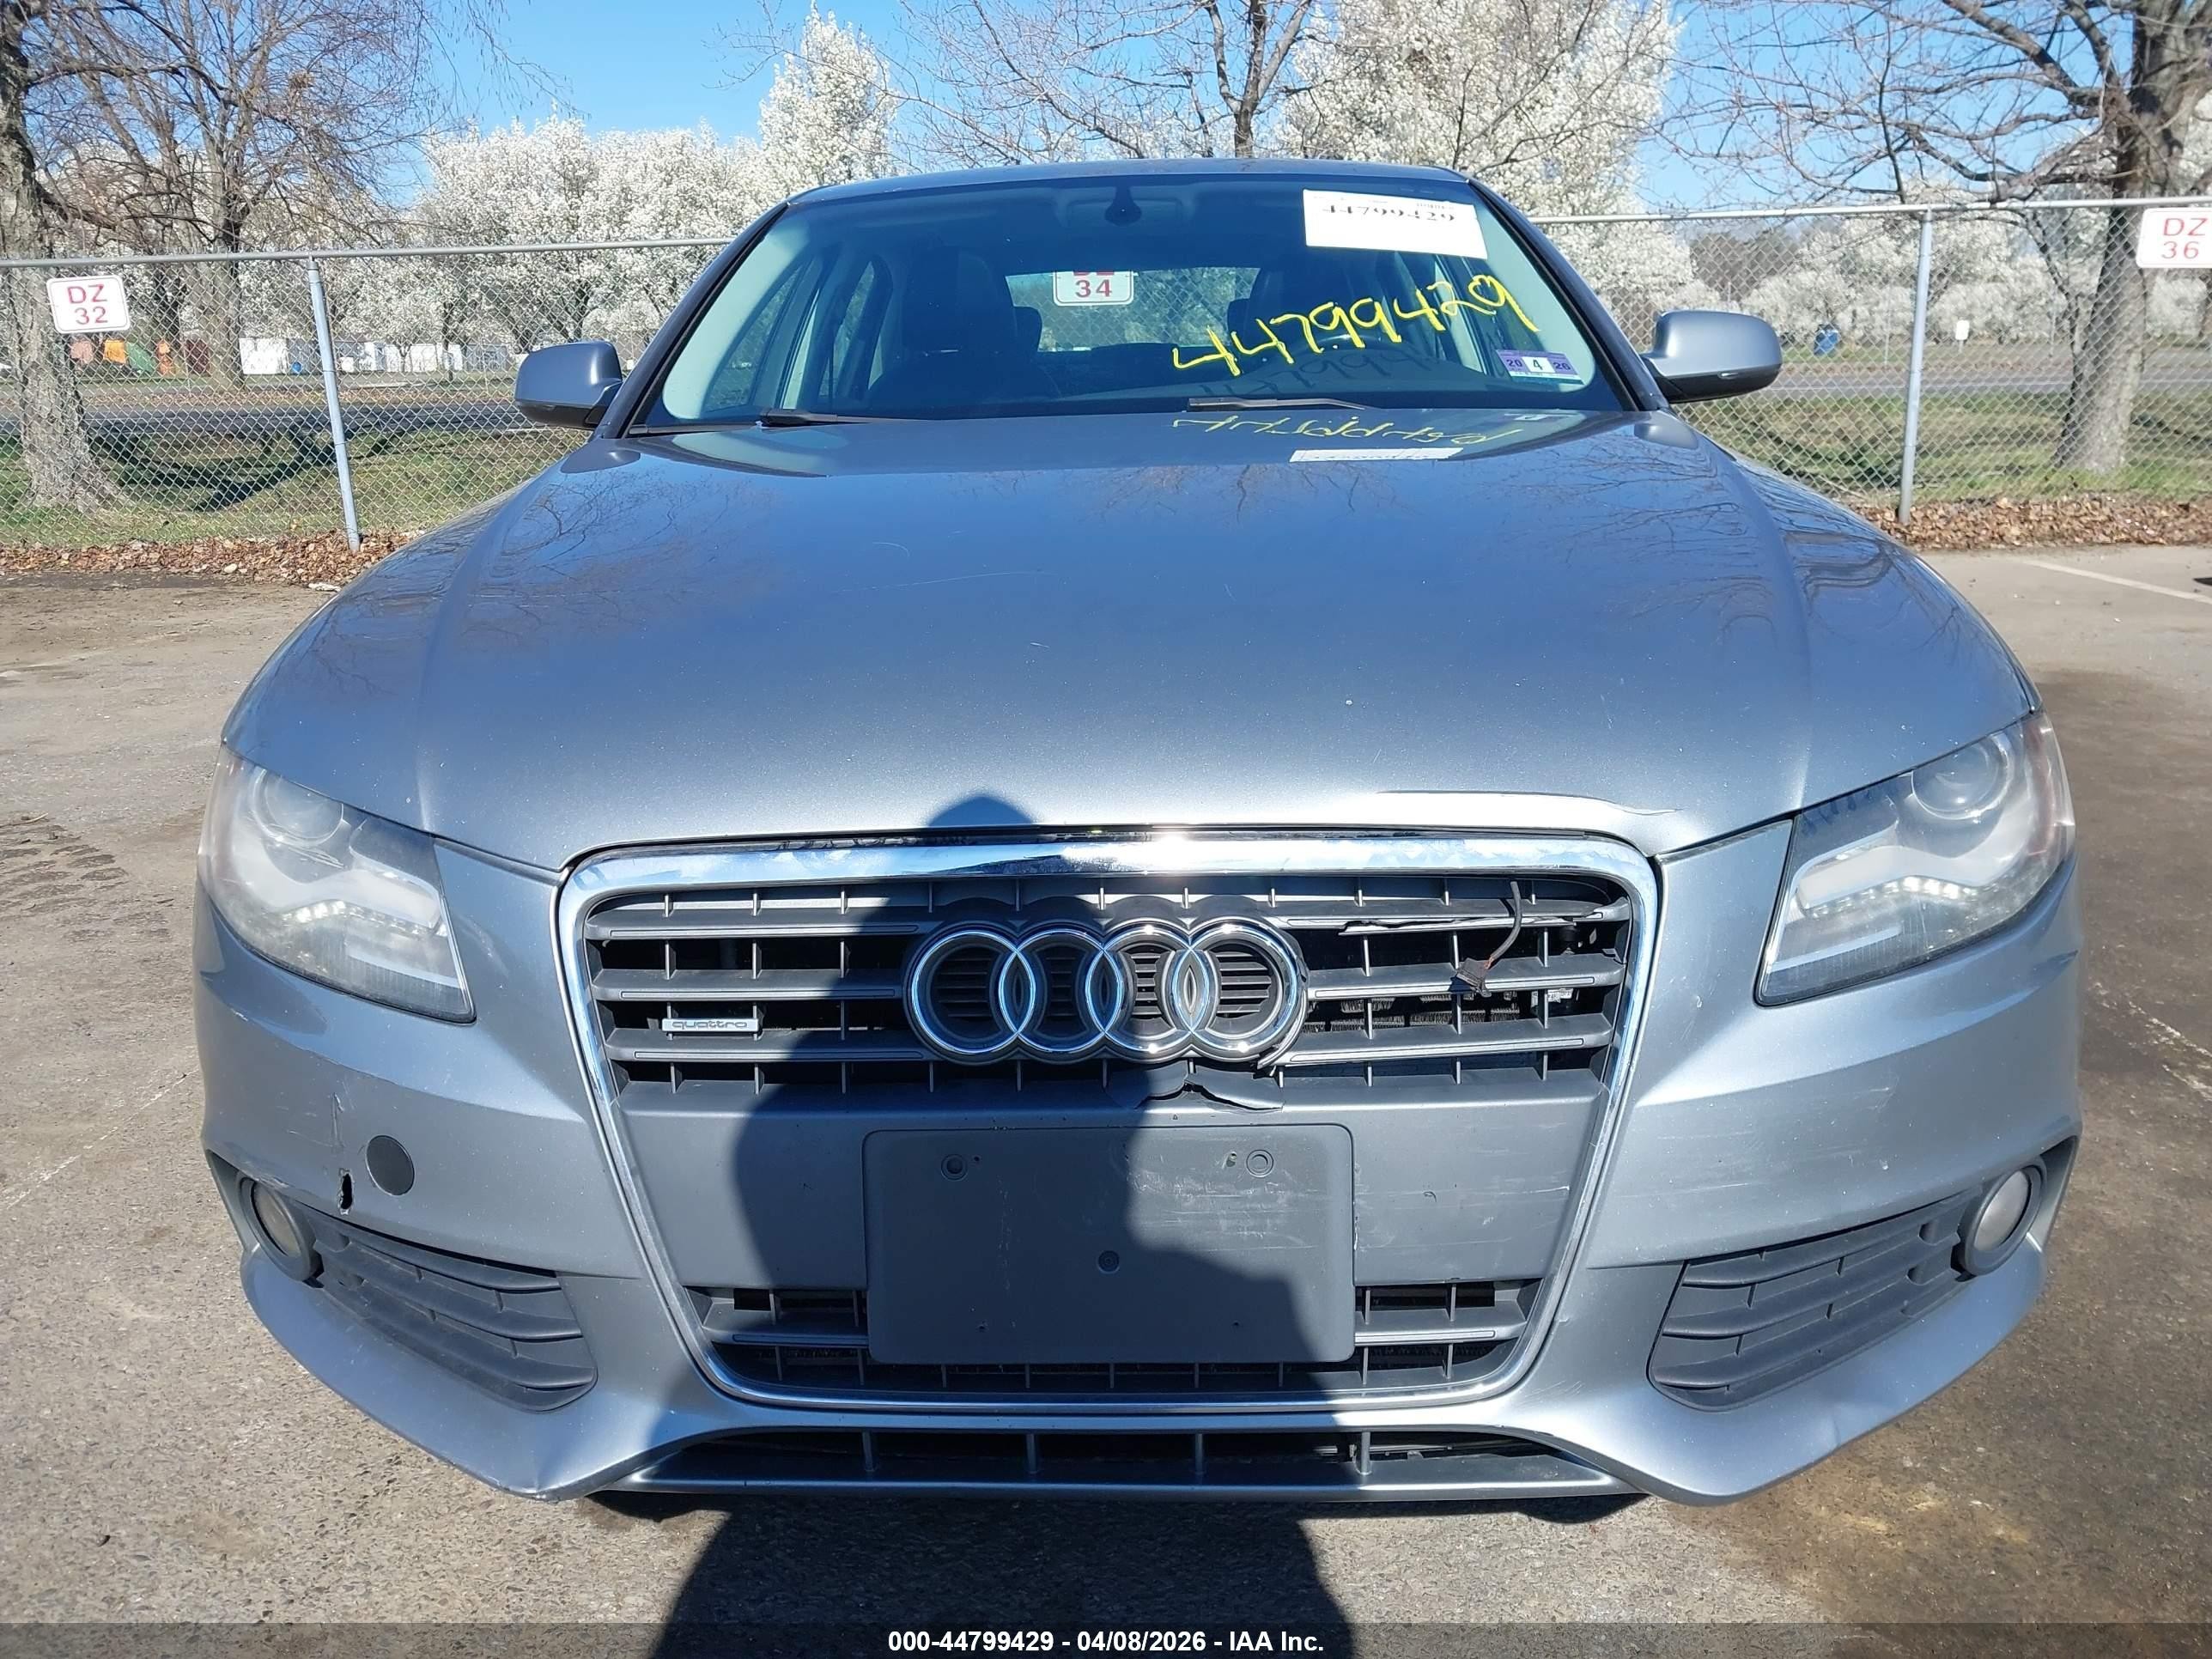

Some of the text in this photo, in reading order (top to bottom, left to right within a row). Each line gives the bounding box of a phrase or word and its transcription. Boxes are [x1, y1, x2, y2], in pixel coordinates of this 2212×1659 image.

[2163, 217, 2209, 236] DZ
[2161, 240, 2200, 259] 36
[67, 284, 108, 304] DZ
[1075, 279, 1113, 298] 34
[74, 306, 109, 325] 32
[1172, 274, 1541, 376] 44799429
[1506, 359, 1523, 368] 20
[1533, 359, 1544, 371] 4
[672, 1020, 749, 1030] quattro
